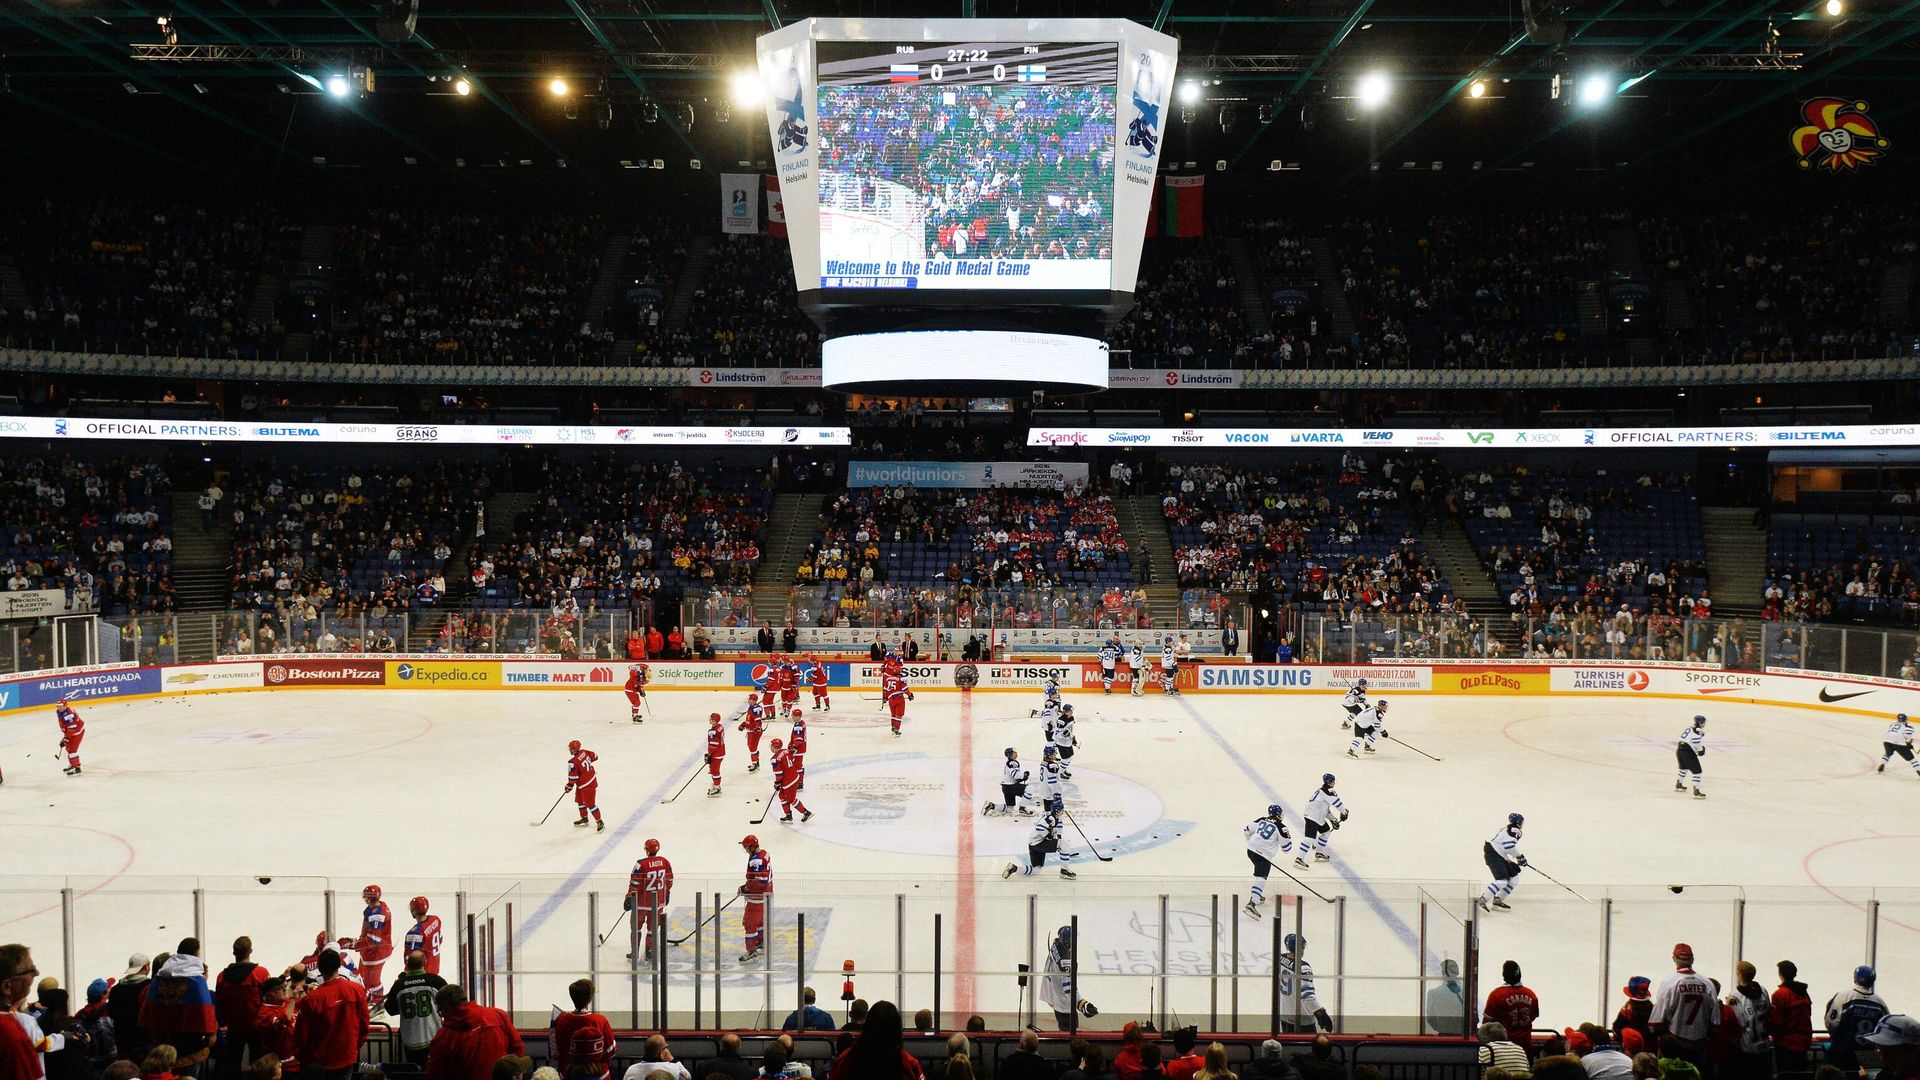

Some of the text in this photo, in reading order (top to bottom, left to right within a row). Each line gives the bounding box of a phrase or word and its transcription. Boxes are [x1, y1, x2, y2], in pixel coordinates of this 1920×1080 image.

[896, 46, 915, 54] RUS
[1023, 46, 1039, 54] FIN
[947, 50, 988, 62] 27:22
[930, 64, 944, 81] 0
[966, 66, 971, 74] 1
[993, 64, 1006, 81] 0
[781, 158, 809, 174] FINLAND
[1125, 160, 1153, 175] FINLAND
[785, 173, 808, 184] Helsinki
[1126, 173, 1150, 186] Helsinki
[826, 260, 1031, 275] Welcome to the Gold Medal Game
[716, 372, 766, 382] Lindström
[1182, 374, 1232, 384] Lindström
[87, 423, 241, 436] OFFICIAL PARTNERS:
[258, 428, 320, 436] BILTEMA
[397, 428, 438, 439] GRANO
[1041, 431, 1088, 443] Scandic
[1225, 434, 1269, 442] VACON
[1302, 433, 1344, 442] VARTA
[1467, 432, 1495, 444] VR
[1531, 434, 1561, 442] XBOX
[1611, 432, 1758, 442] OFFICIAL PARTNERS:
[1777, 432, 1846, 440] BILTEMA
[856, 467, 965, 483] #worldjuniors
[1104, 651, 1114, 660] 24
[213, 672, 260, 680] CHEVROLET
[288, 668, 380, 680] Boston Pizza
[417, 667, 487, 683] Expedia.ca
[507, 673, 586, 682] TIMBER MART
[658, 669, 724, 680] Stick Together
[1013, 668, 1070, 678] TISSOT
[1203, 669, 1312, 686] SAMSUNG
[1332, 670, 1416, 679] WORLDJUNIOR2017.COM
[1574, 671, 1624, 680] TURKISH
[40, 673, 141, 690] #ALLHEARTCANADA
[1574, 680, 1625, 689] AIRLINES
[85, 685, 118, 695] TELUS
[647, 870, 666, 891] 23
[1679, 984, 1707, 993] CARTER
[400, 990, 432, 1019] 68
[1505, 994, 1533, 1006] CANADA
[1682, 994, 1702, 1026] 7
